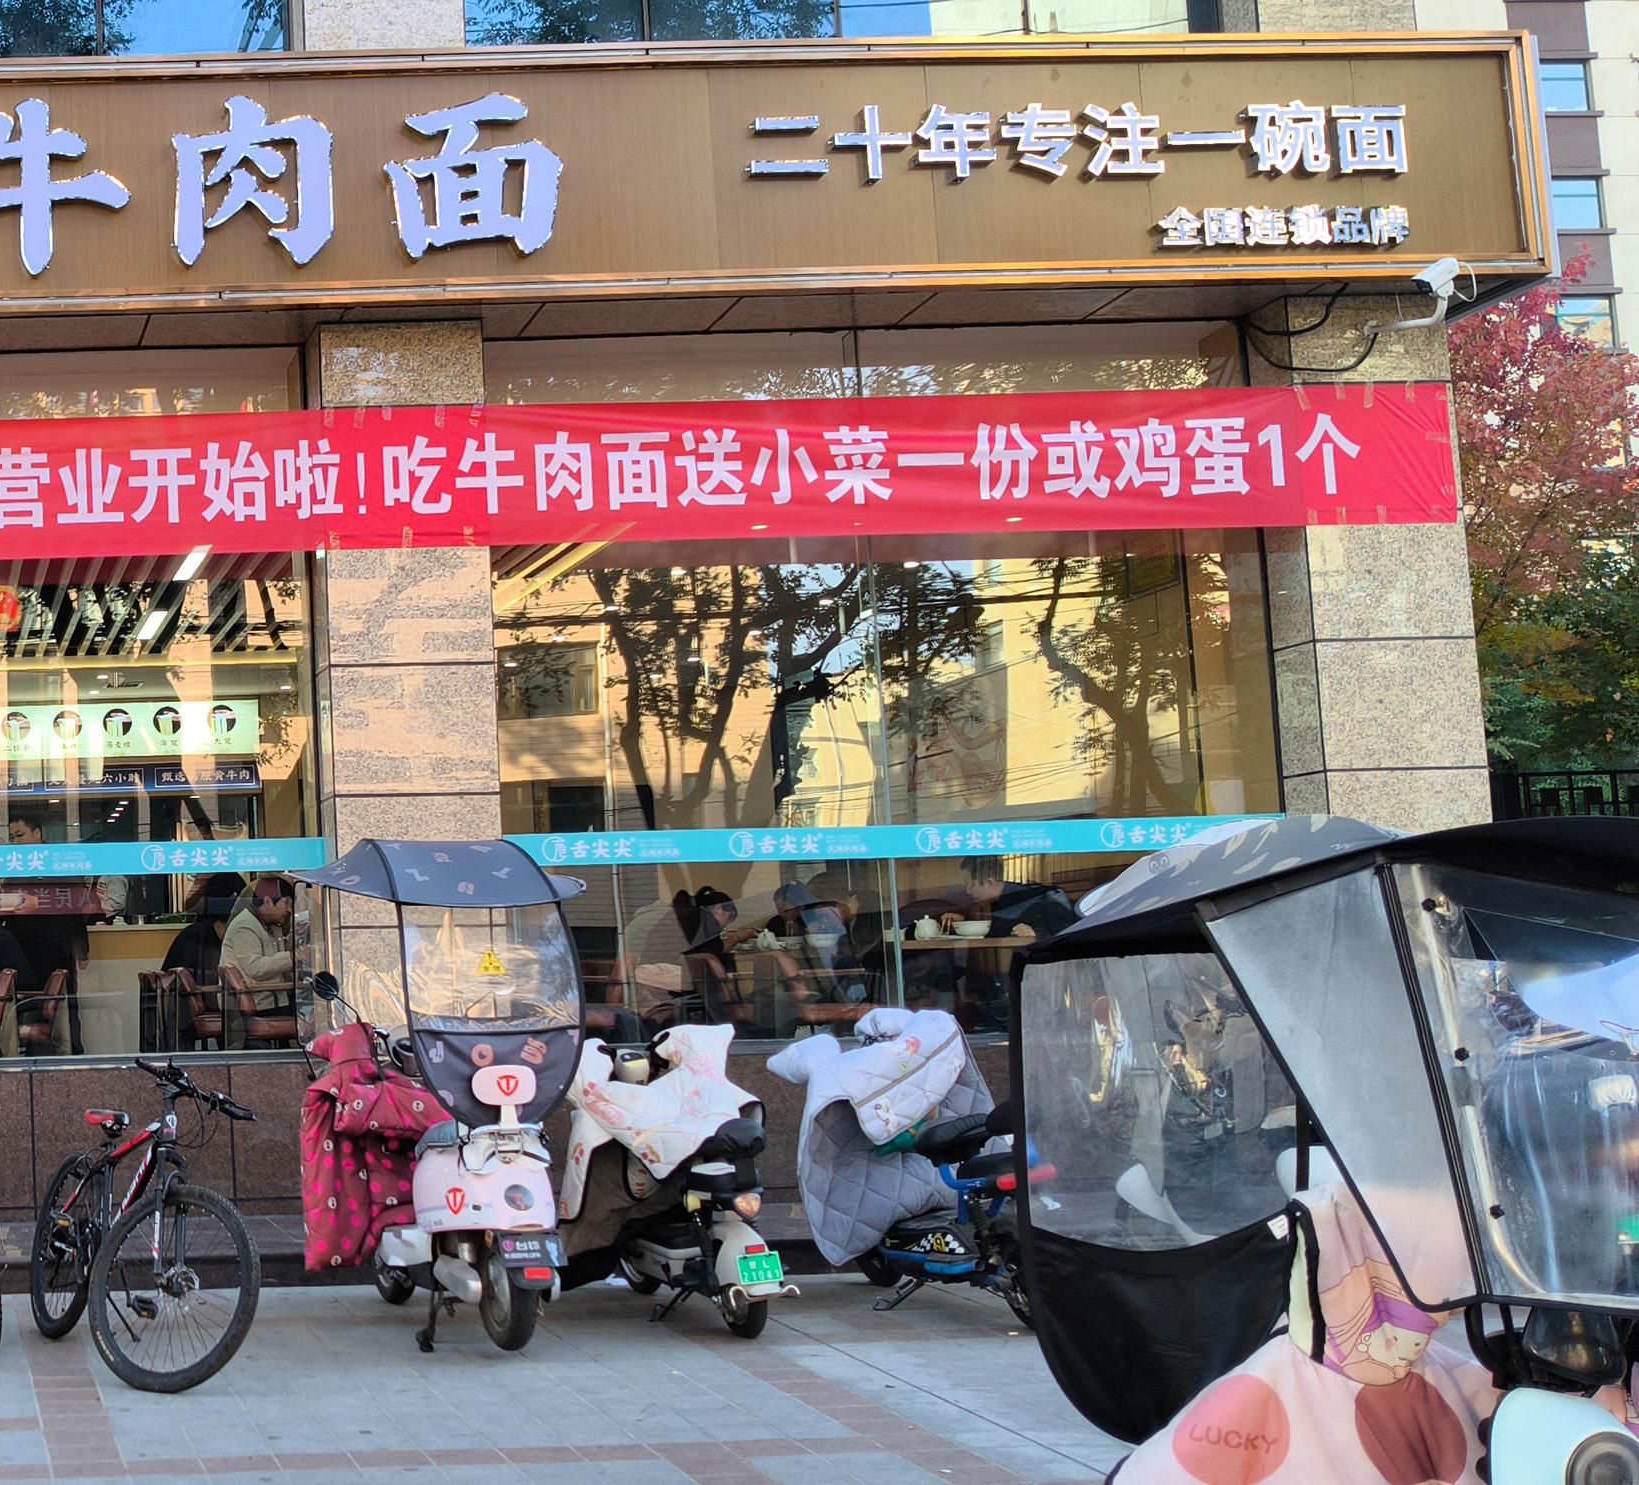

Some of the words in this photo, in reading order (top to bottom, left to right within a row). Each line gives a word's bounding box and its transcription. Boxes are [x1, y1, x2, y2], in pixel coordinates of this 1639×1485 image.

[745, 99, 1410, 184] 二十年专注一碗面
[1154, 203, 1410, 251] 全国连锁品牌
[570, 838, 632, 859] 舌尖尖
[758, 833, 819, 855] 舌尖尖
[944, 828, 1006, 849] 舌尖尖
[169, 846, 230, 868] 舌尖尖
[742, 1269, 780, 1283] 21041
[1188, 1423, 1279, 1456] LUCKY
